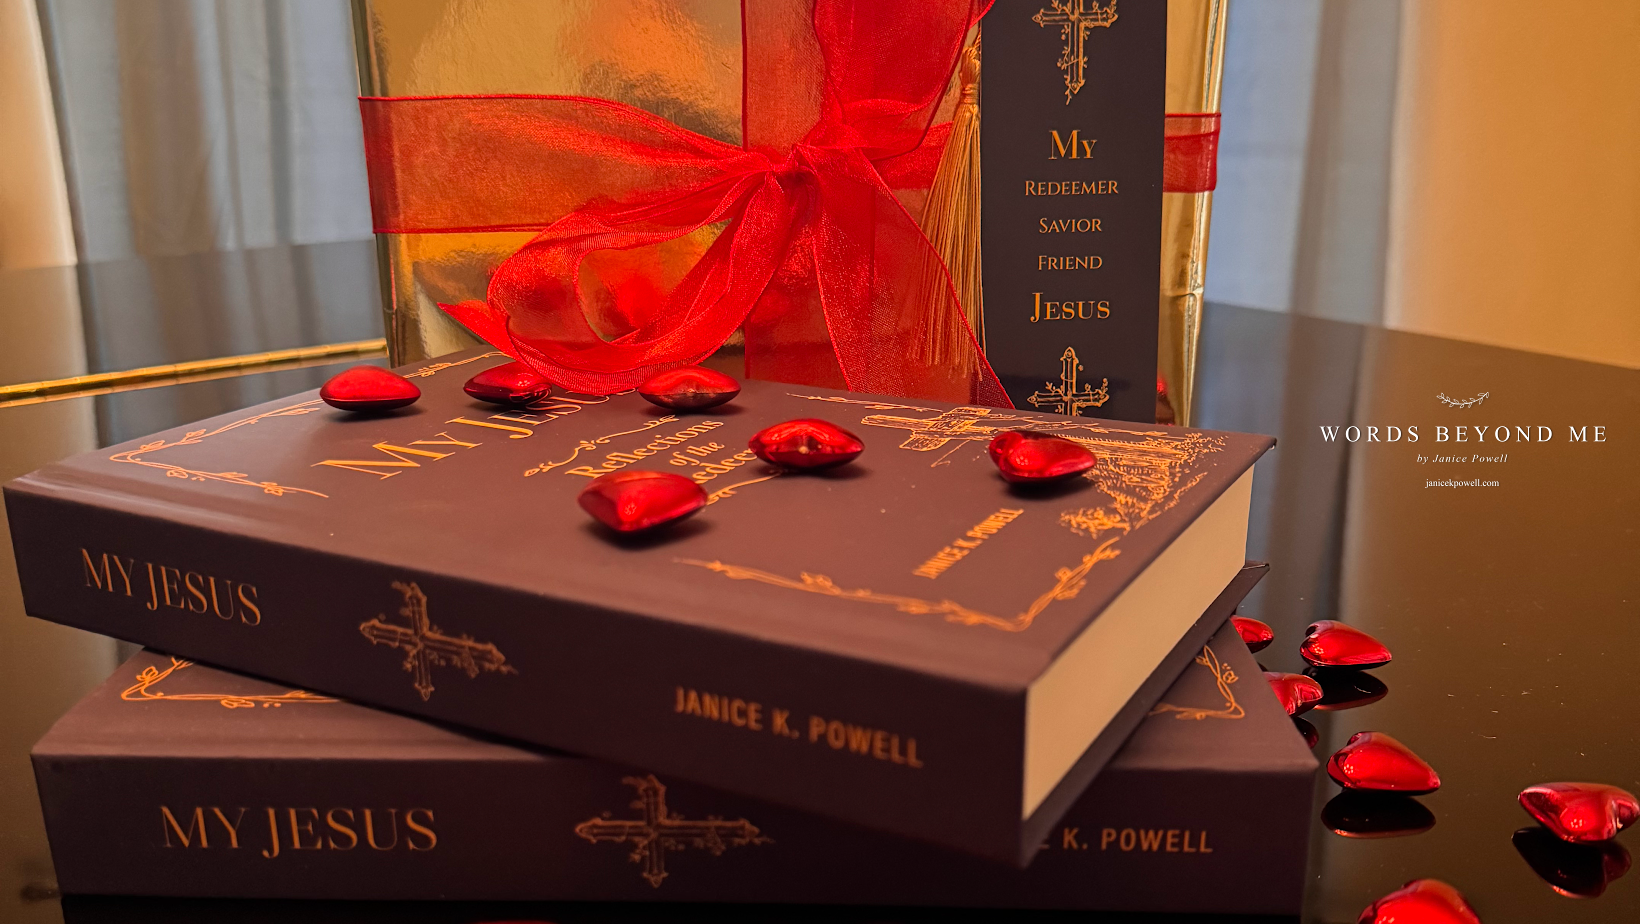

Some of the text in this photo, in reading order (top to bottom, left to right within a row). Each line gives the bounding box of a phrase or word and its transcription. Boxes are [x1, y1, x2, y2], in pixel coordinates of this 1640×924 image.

[1024, 180, 1119, 196] REDEEMER
[1038, 217, 1102, 234] SAVIOR
[1037, 255, 1103, 271] FRIEND
[1030, 292, 1111, 323] JESUS
[444, 387, 637, 440] JESU
[565, 420, 724, 479] Reflections
[669, 441, 725, 467] of the
[911, 545, 971, 580] JANICE
[966, 507, 1025, 540] POWELL
[81, 547, 262, 626] MY JESUS
[675, 686, 924, 769] JANICE K. POWELL
[160, 804, 439, 860] MY JESUS
[1062, 826, 1089, 851] K.
[1101, 827, 1214, 854] POWELL
